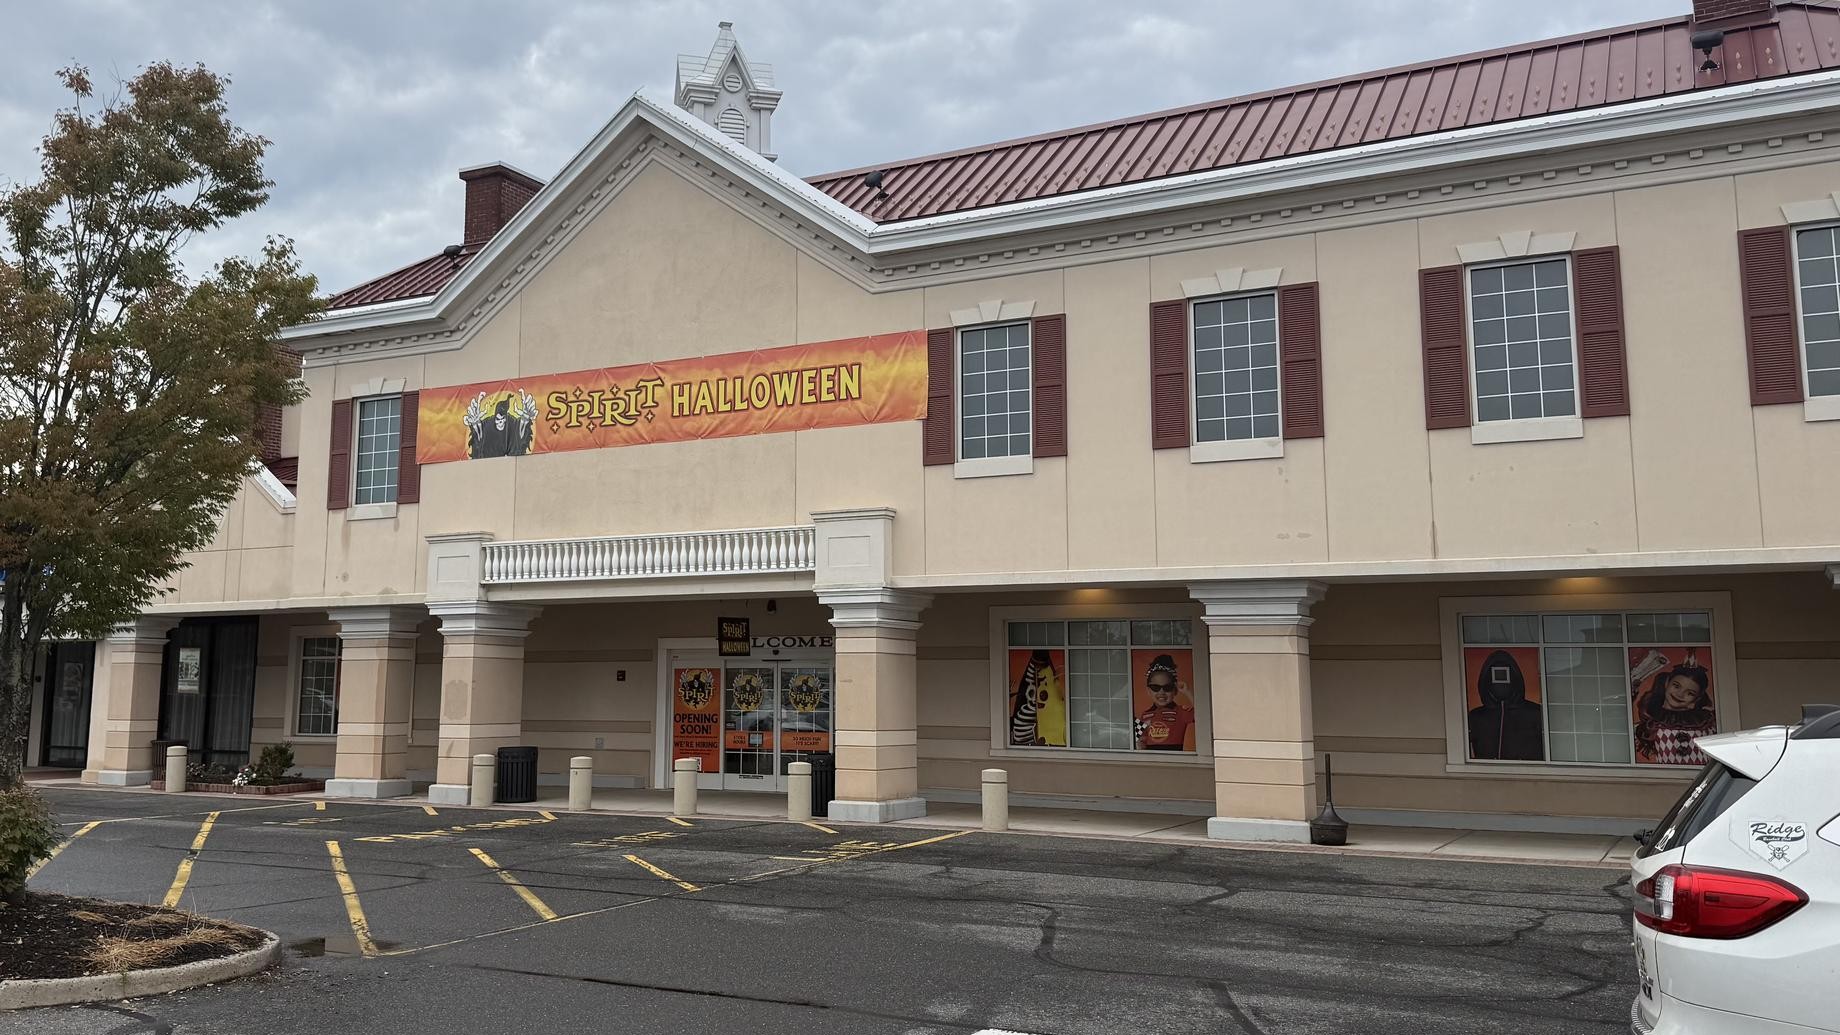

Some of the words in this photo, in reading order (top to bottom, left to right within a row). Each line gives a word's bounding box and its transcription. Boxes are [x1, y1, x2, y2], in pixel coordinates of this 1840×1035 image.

[546, 376, 665, 428] SPIRIT
[671, 362, 862, 417] HALLOWEEN
[722, 622, 747, 638] SPIRIT
[722, 641, 749, 653] HALLOWEEN
[751, 637, 833, 648] LCOME
[678, 687, 715, 702] SPIRIT
[735, 691, 761, 702] SPIRIT
[791, 691, 818, 703] SPIRIT
[674, 713, 718, 724] OPENING
[680, 724, 712, 735] SOON!
[1750, 822, 1804, 838] Ridge
